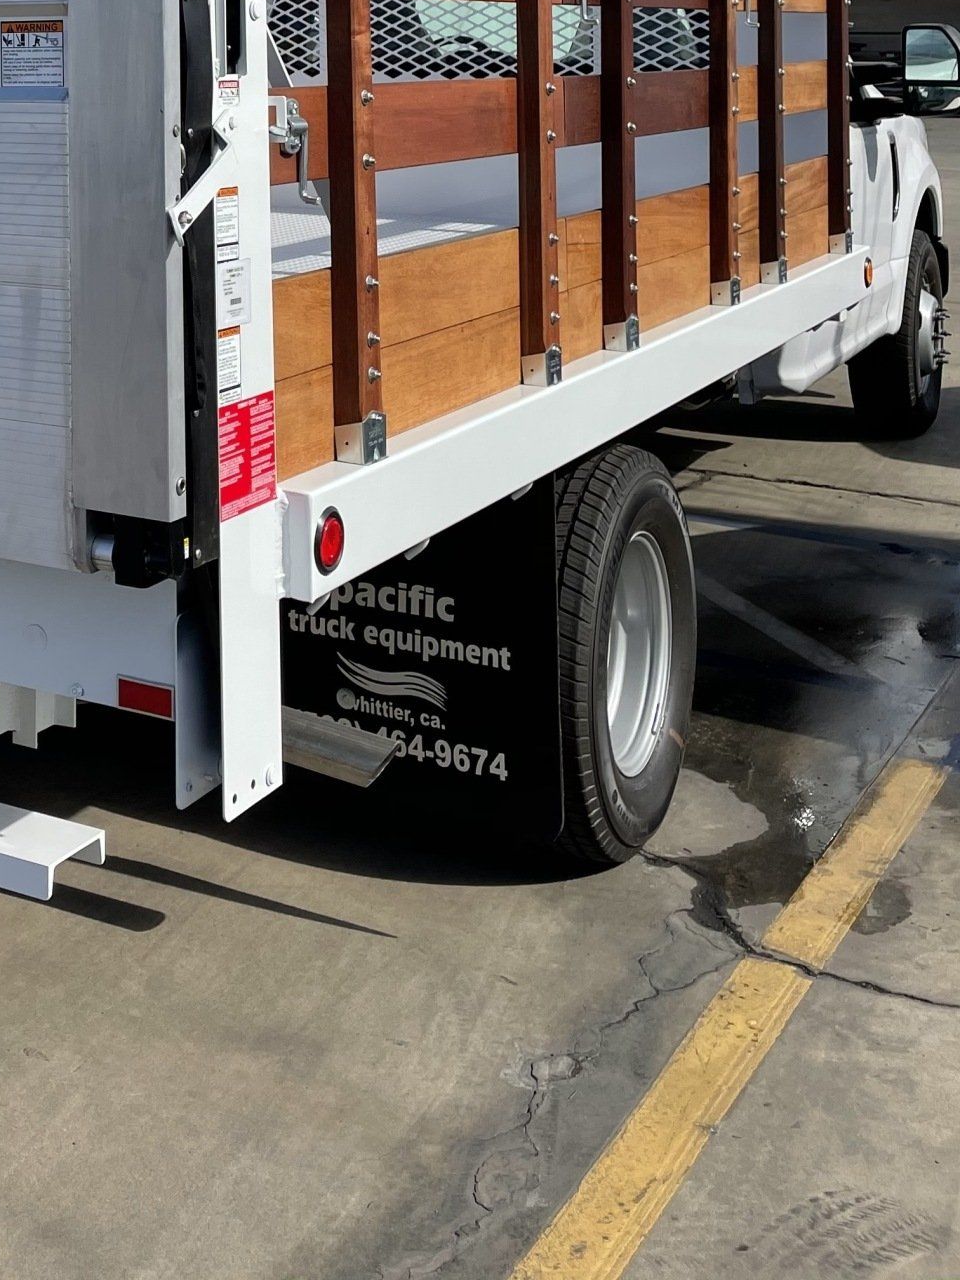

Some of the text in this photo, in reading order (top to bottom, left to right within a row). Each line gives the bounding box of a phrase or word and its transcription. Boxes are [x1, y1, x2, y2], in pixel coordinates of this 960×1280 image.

[16, 23, 58, 32] WARNING
[330, 581, 456, 623] pacific
[288, 608, 512, 671] truck equipment
[419, 711, 446, 730] ca.
